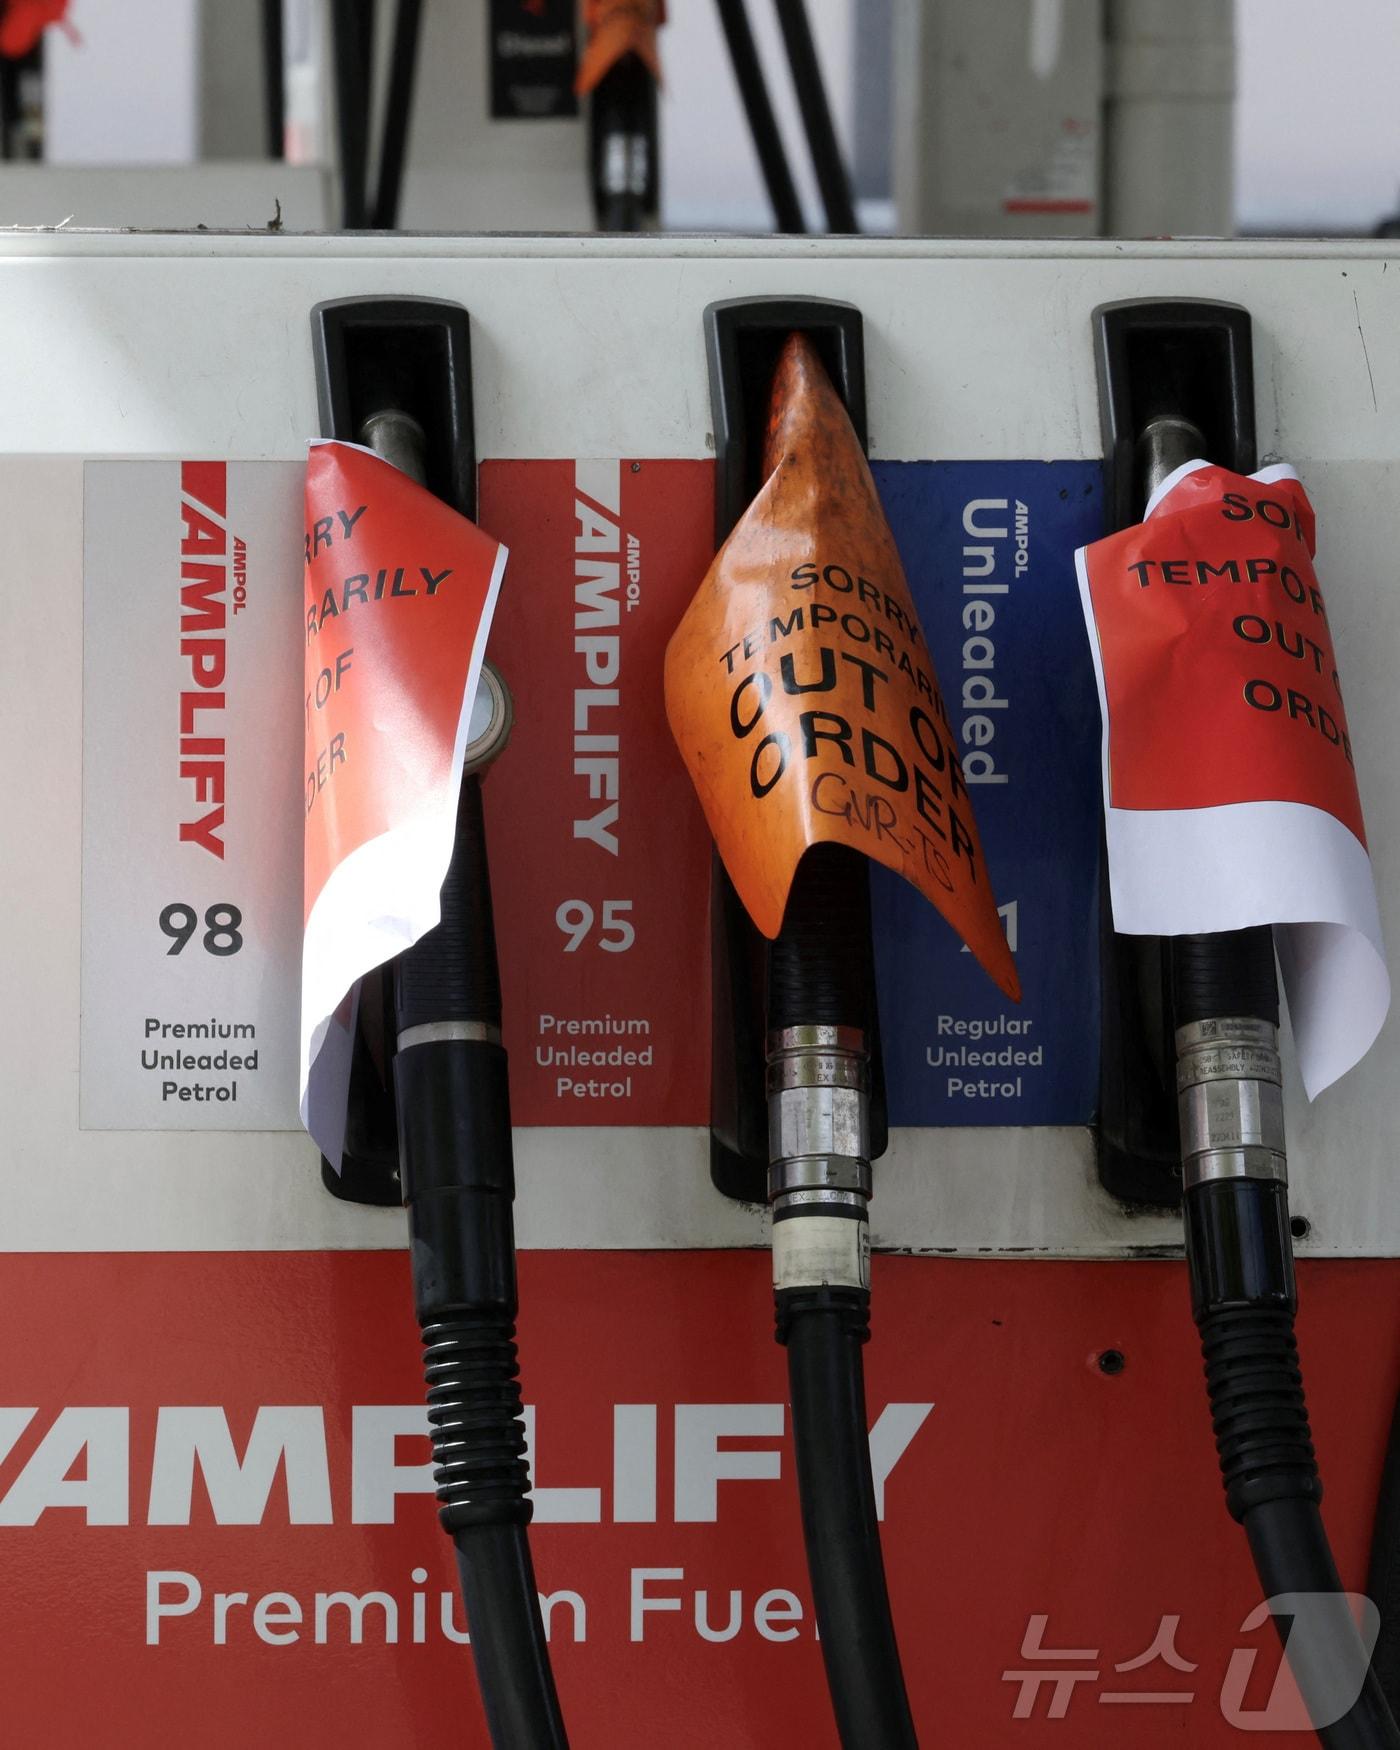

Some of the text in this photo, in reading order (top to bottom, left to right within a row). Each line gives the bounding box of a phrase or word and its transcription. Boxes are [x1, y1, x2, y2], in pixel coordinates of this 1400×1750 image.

[1015, 499, 1029, 578] AMPOL
[233, 535, 247, 615] AMPOL
[626, 533, 641, 612] AMPOL
[790, 563, 919, 645] SORRY
[962, 499, 1009, 784] Unleaded
[1232, 615, 1325, 674] OUT
[179, 500, 227, 861] AMPLIFY
[315, 648, 354, 712] OF
[573, 499, 620, 857] AMPLIFY
[730, 648, 889, 739] OUT
[750, 711, 977, 885] ORDER
[158, 902, 244, 957] 98
[555, 899, 636, 953] 95
[959, 899, 1018, 953] 1
[144, 1017, 256, 1039] Premium
[539, 1014, 650, 1035] Premium
[937, 1014, 1033, 1041] Regular
[140, 1049, 259, 1071] Unleaded
[535, 1045, 653, 1067] Unleaded
[926, 1045, 1043, 1067] Unleaded
[162, 1080, 237, 1102] Petrol
[556, 1076, 632, 1098] Petrol
[947, 1077, 1022, 1098] Petrol
[630, 1566, 821, 1643] Fue
